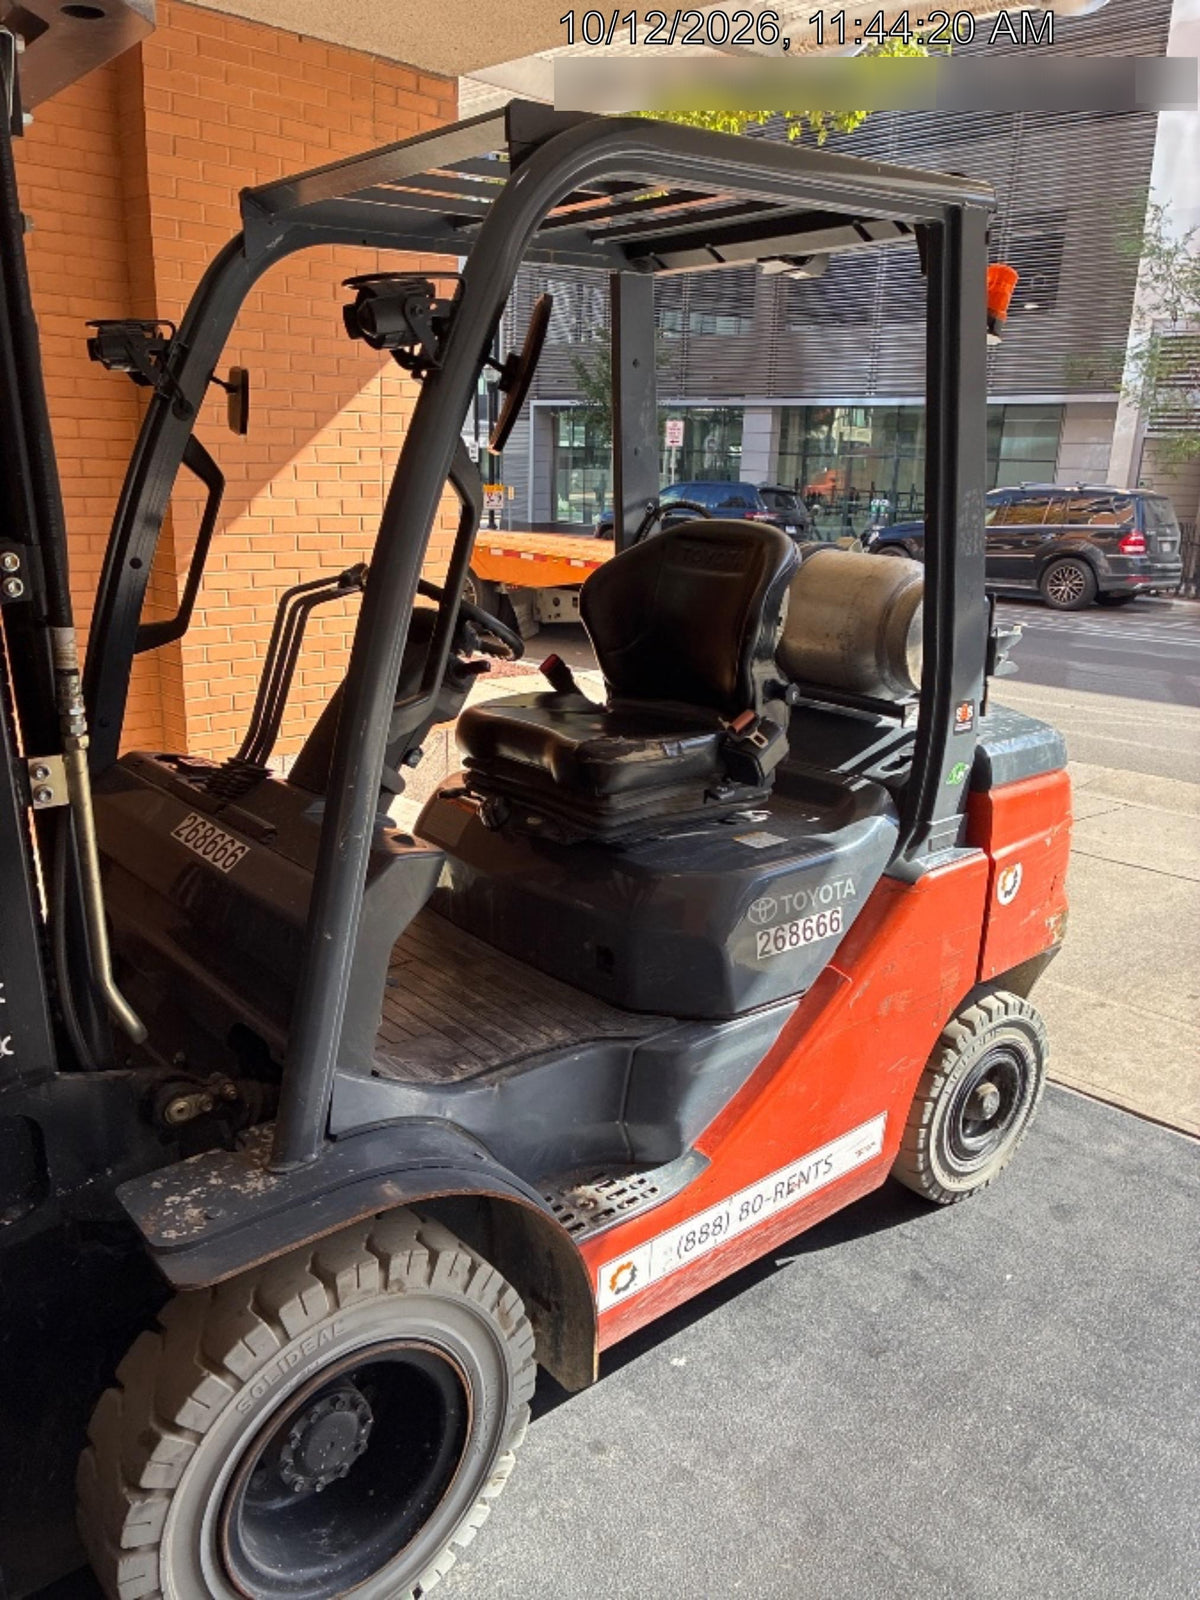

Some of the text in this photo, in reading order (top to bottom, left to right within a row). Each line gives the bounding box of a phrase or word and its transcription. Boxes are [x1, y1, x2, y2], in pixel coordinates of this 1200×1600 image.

[174, 815, 246, 870] 268666
[780, 877, 856, 914] TOYOTA
[758, 909, 841, 957] 268666
[676, 1210, 730, 1260] (888)
[738, 1153, 834, 1222] 80-RENTS
[236, 1320, 346, 1415] SOLIDEAL
